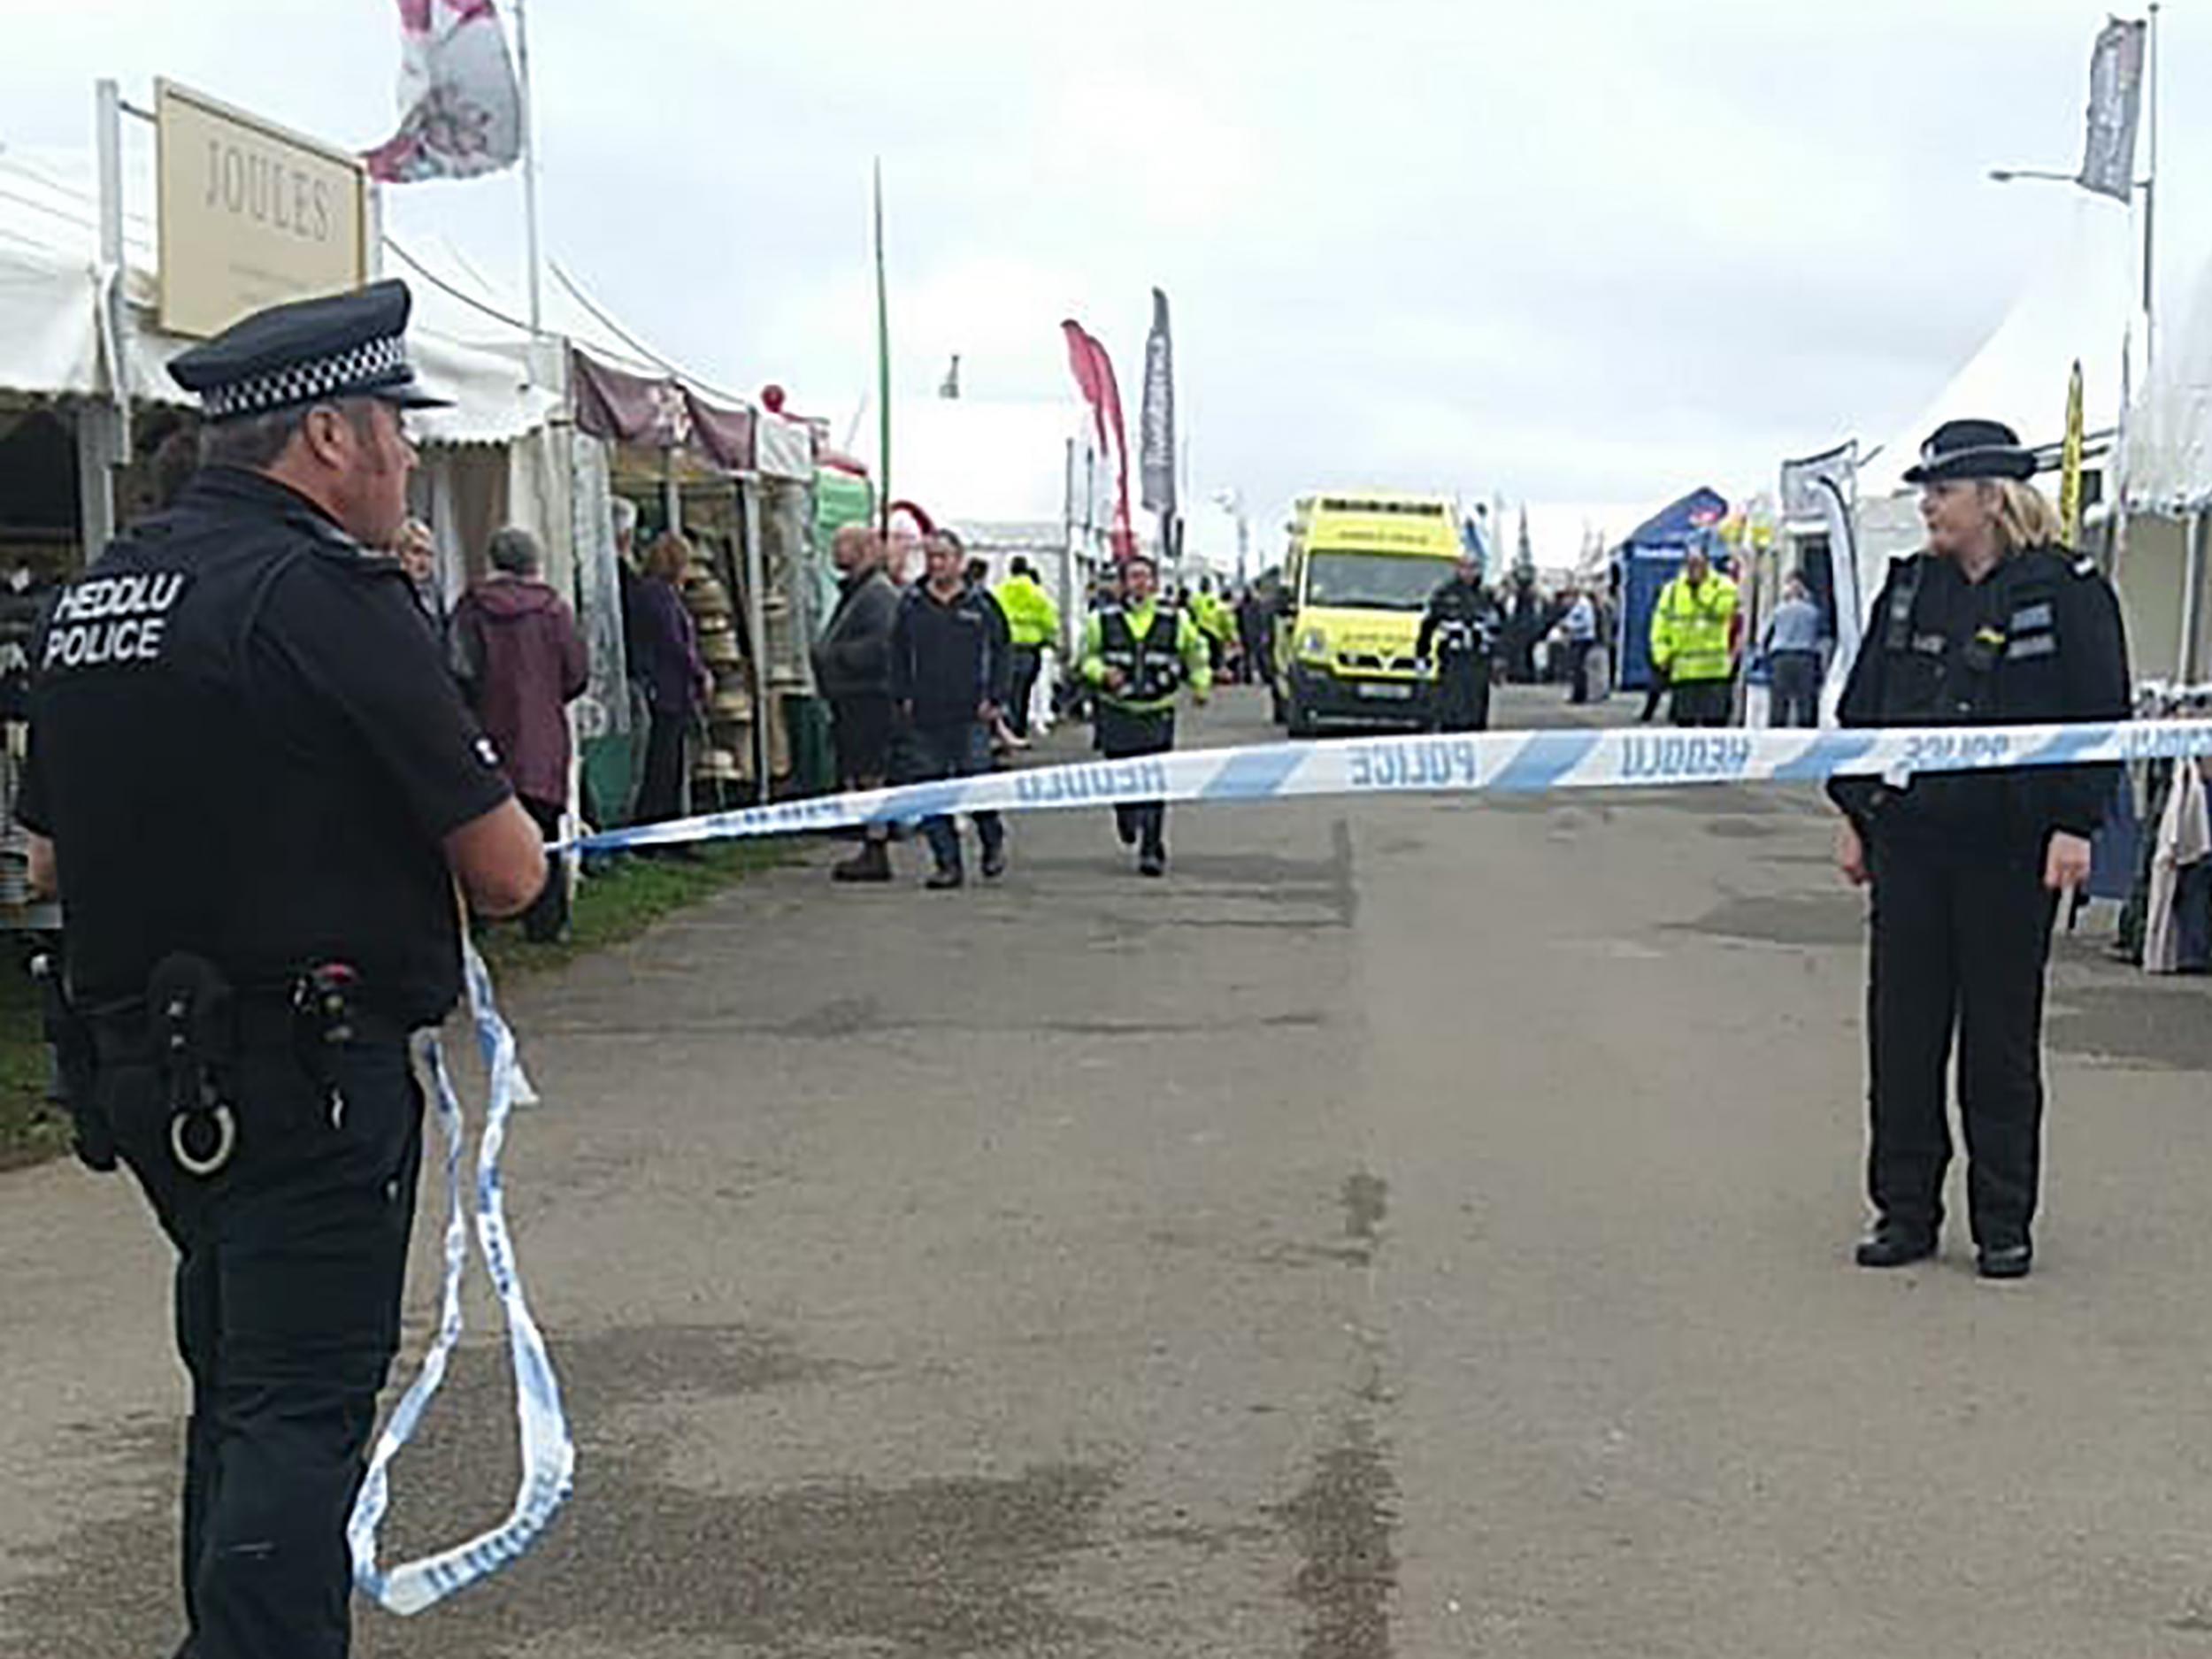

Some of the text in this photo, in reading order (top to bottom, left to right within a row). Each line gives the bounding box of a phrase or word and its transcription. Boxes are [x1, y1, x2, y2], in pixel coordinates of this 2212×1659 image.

[205, 139, 328, 242] JOULES
[53, 572, 183, 622] HEDDLU
[42, 618, 165, 670] POLICE
